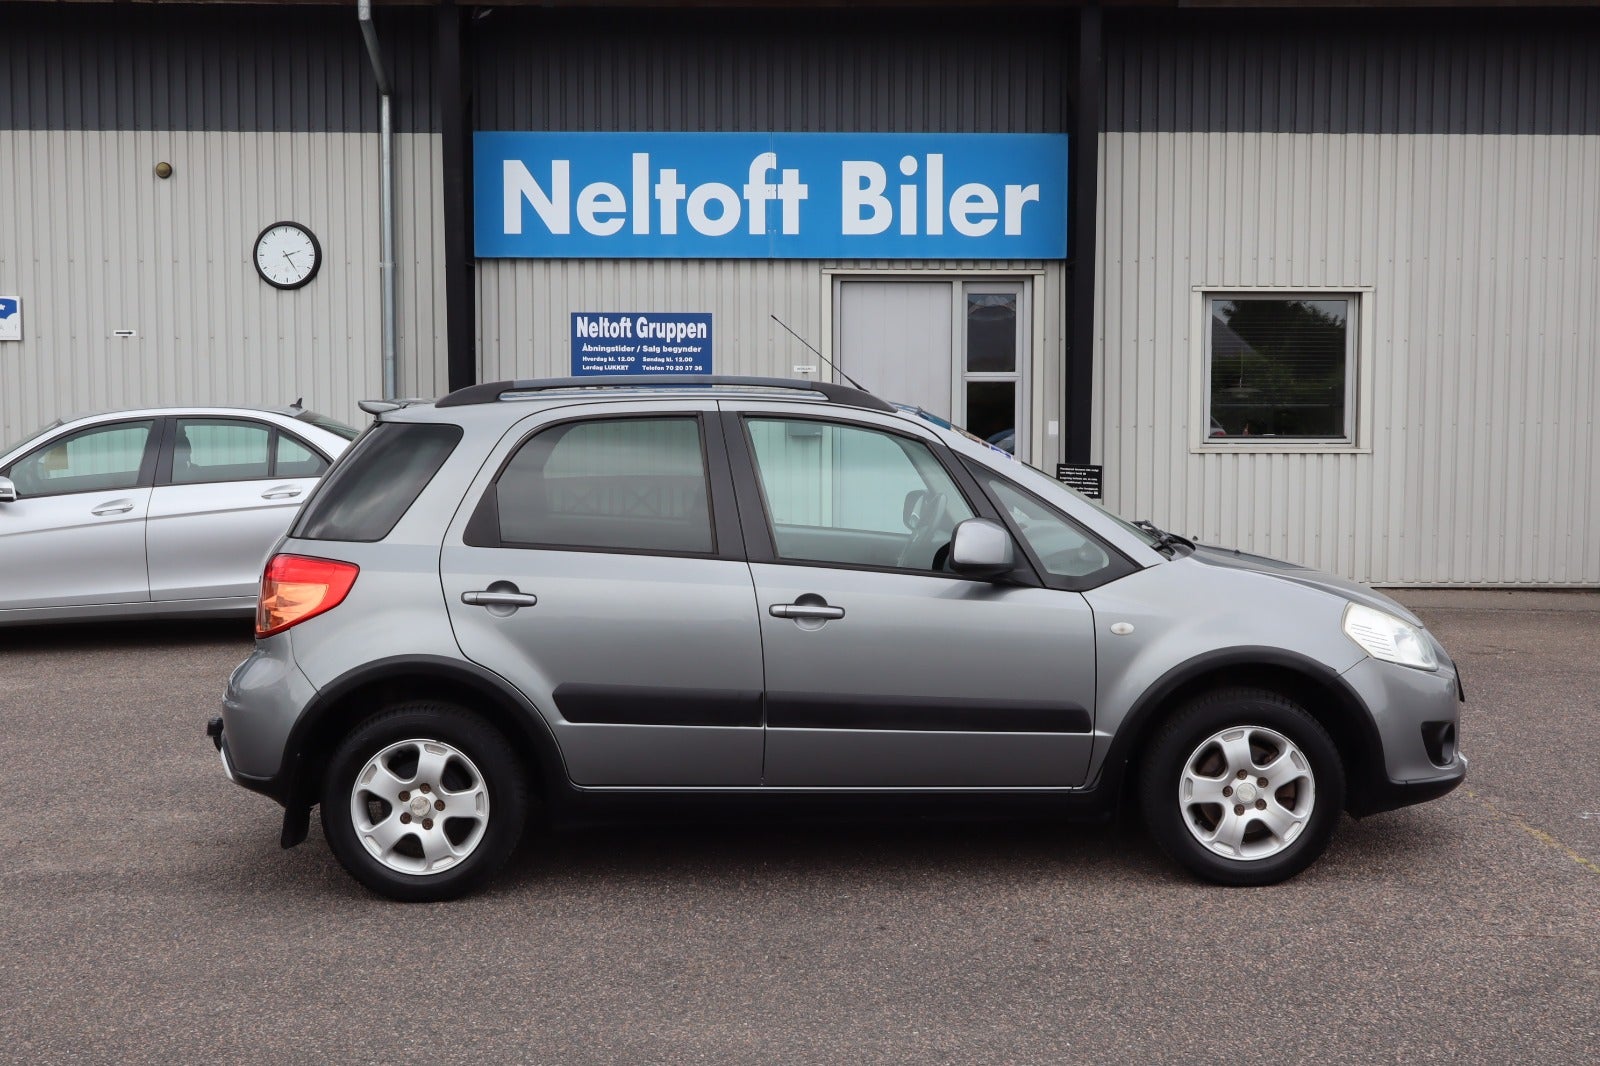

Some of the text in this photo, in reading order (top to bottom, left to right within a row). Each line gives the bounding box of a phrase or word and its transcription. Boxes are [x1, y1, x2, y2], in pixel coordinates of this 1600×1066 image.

[502, 152, 1039, 237] Neltoft Biler
[576, 316, 707, 343] Neltoft Gruppen
[582, 343, 702, 354] Åbningstider / Salg begynder
